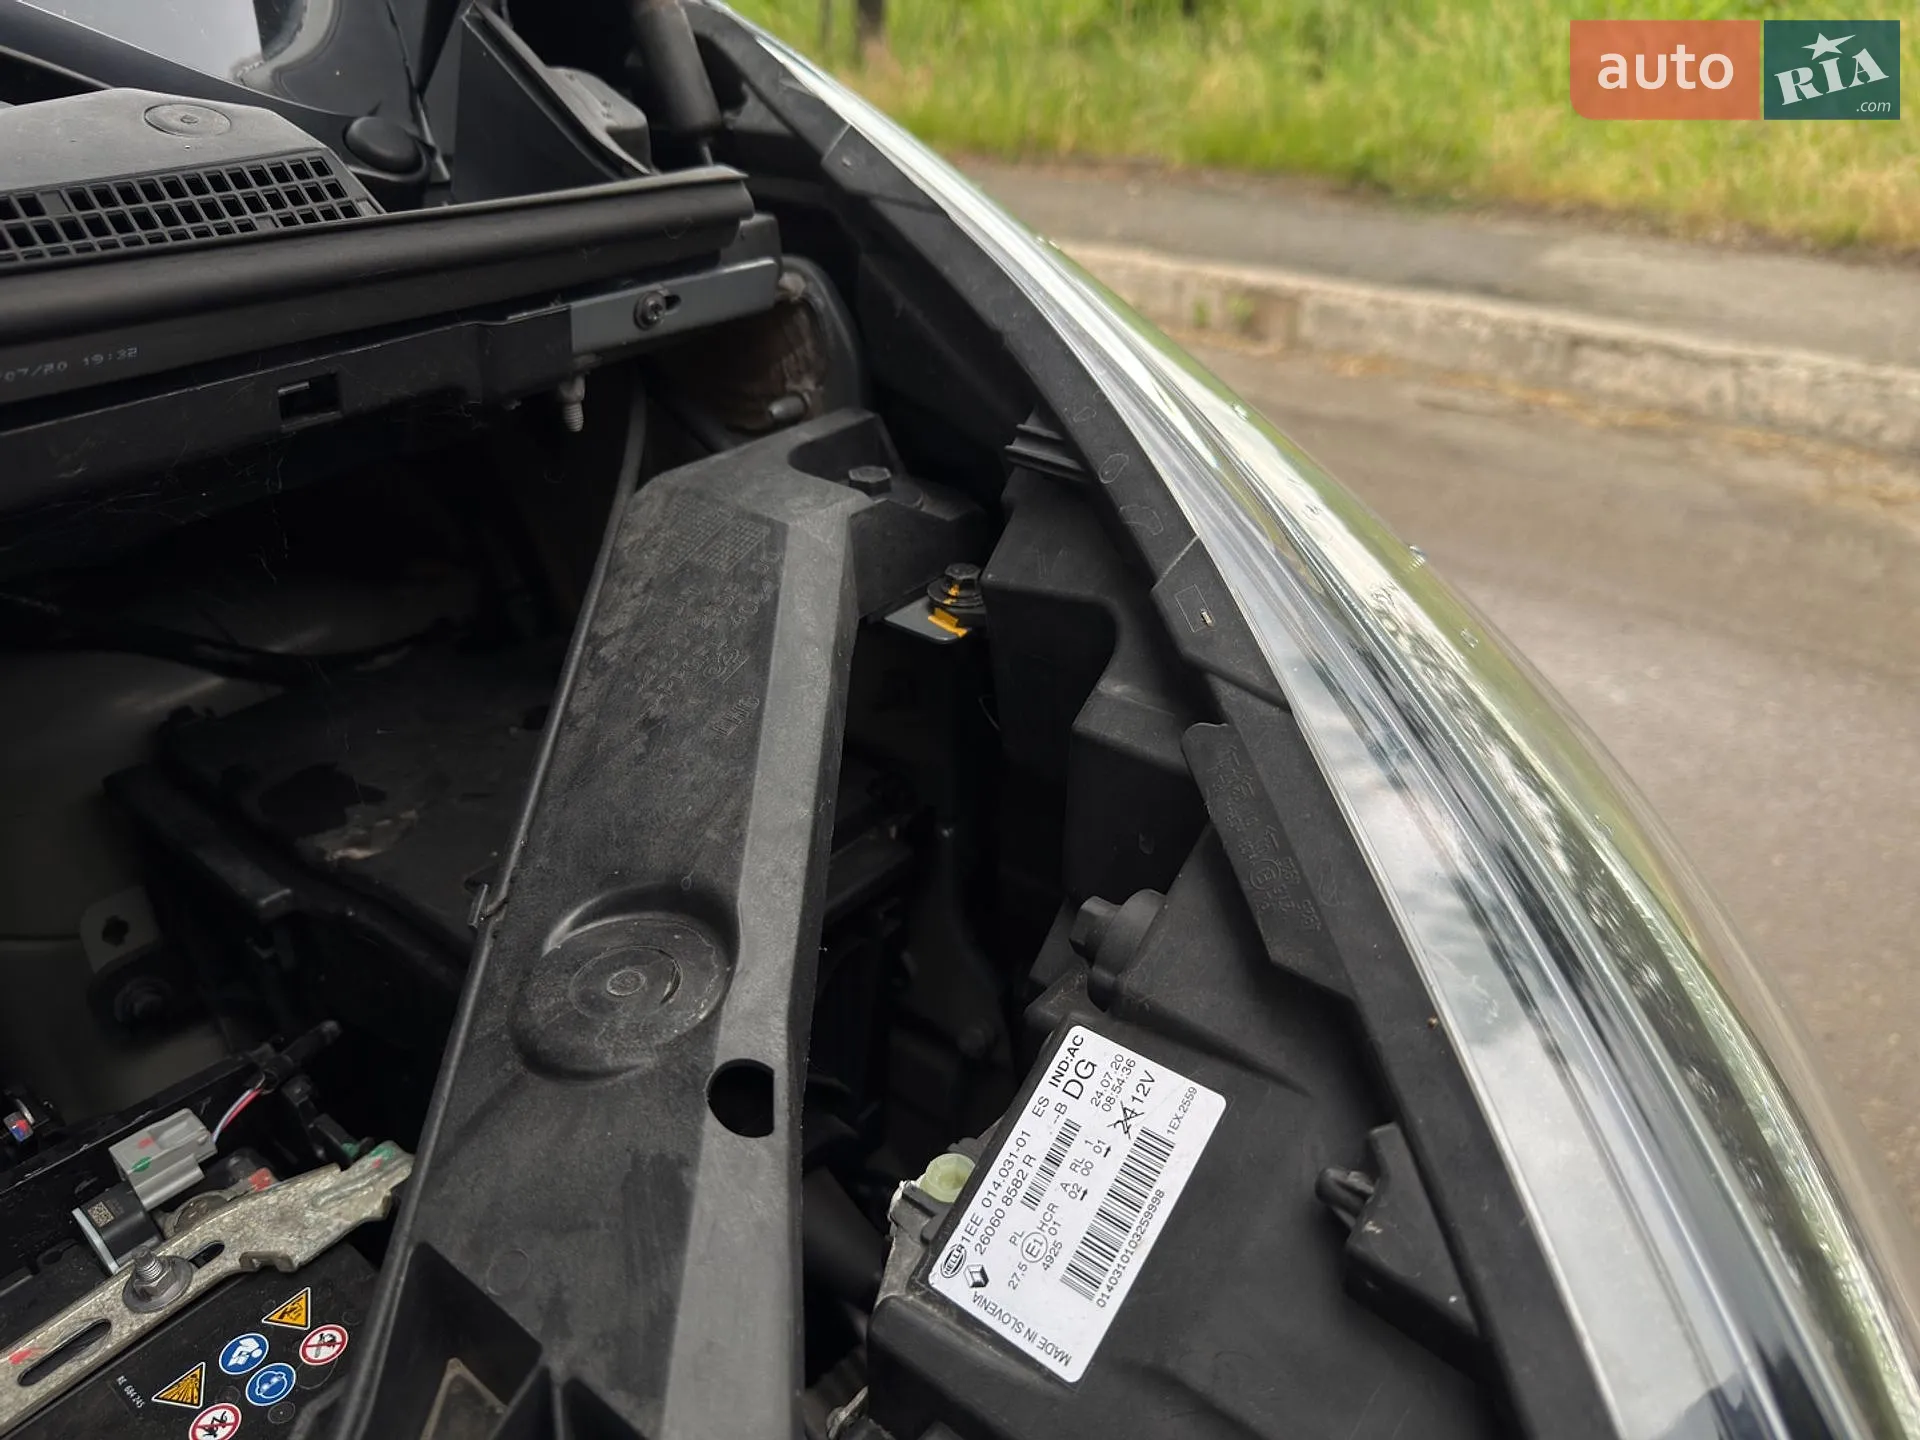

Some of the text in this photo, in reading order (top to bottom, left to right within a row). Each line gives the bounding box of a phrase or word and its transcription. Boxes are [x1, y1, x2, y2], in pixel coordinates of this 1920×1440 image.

[0, 360, 70, 382] 07/20
[1062, 1059, 1097, 1100] DG
[1090, 1054, 1125, 1107] 24.07.20
[1101, 1058, 1136, 1112] 08:54:36
[1131, 1070, 1155, 1103] 12V
[1167, 1087, 1197, 1134] 1EX.2559
[961, 1213, 983, 1242] 1EE
[981, 1130, 1030, 1208] 014.031-01
[1032, 1096, 1049, 1117] ES
[1048, 1035, 1084, 1088] IND:AC
[974, 1208, 1005, 1255] 26060
[1001, 1169, 1028, 1206] 8582
[1022, 1154, 1036, 1167] R
[1025, 1239, 1047, 1258] E1
[1037, 1203, 1058, 1232] HCR
[1060, 1183, 1070, 1192] A
[1069, 1159, 1085, 1173] RL
[1048, 1140, 1105, 1236] 01 02 00 01
[1009, 1232, 1024, 1246] PL
[1041, 1240, 1062, 1271] 4925
[973, 1291, 1071, 1366] MADE IN SLOVENIA
